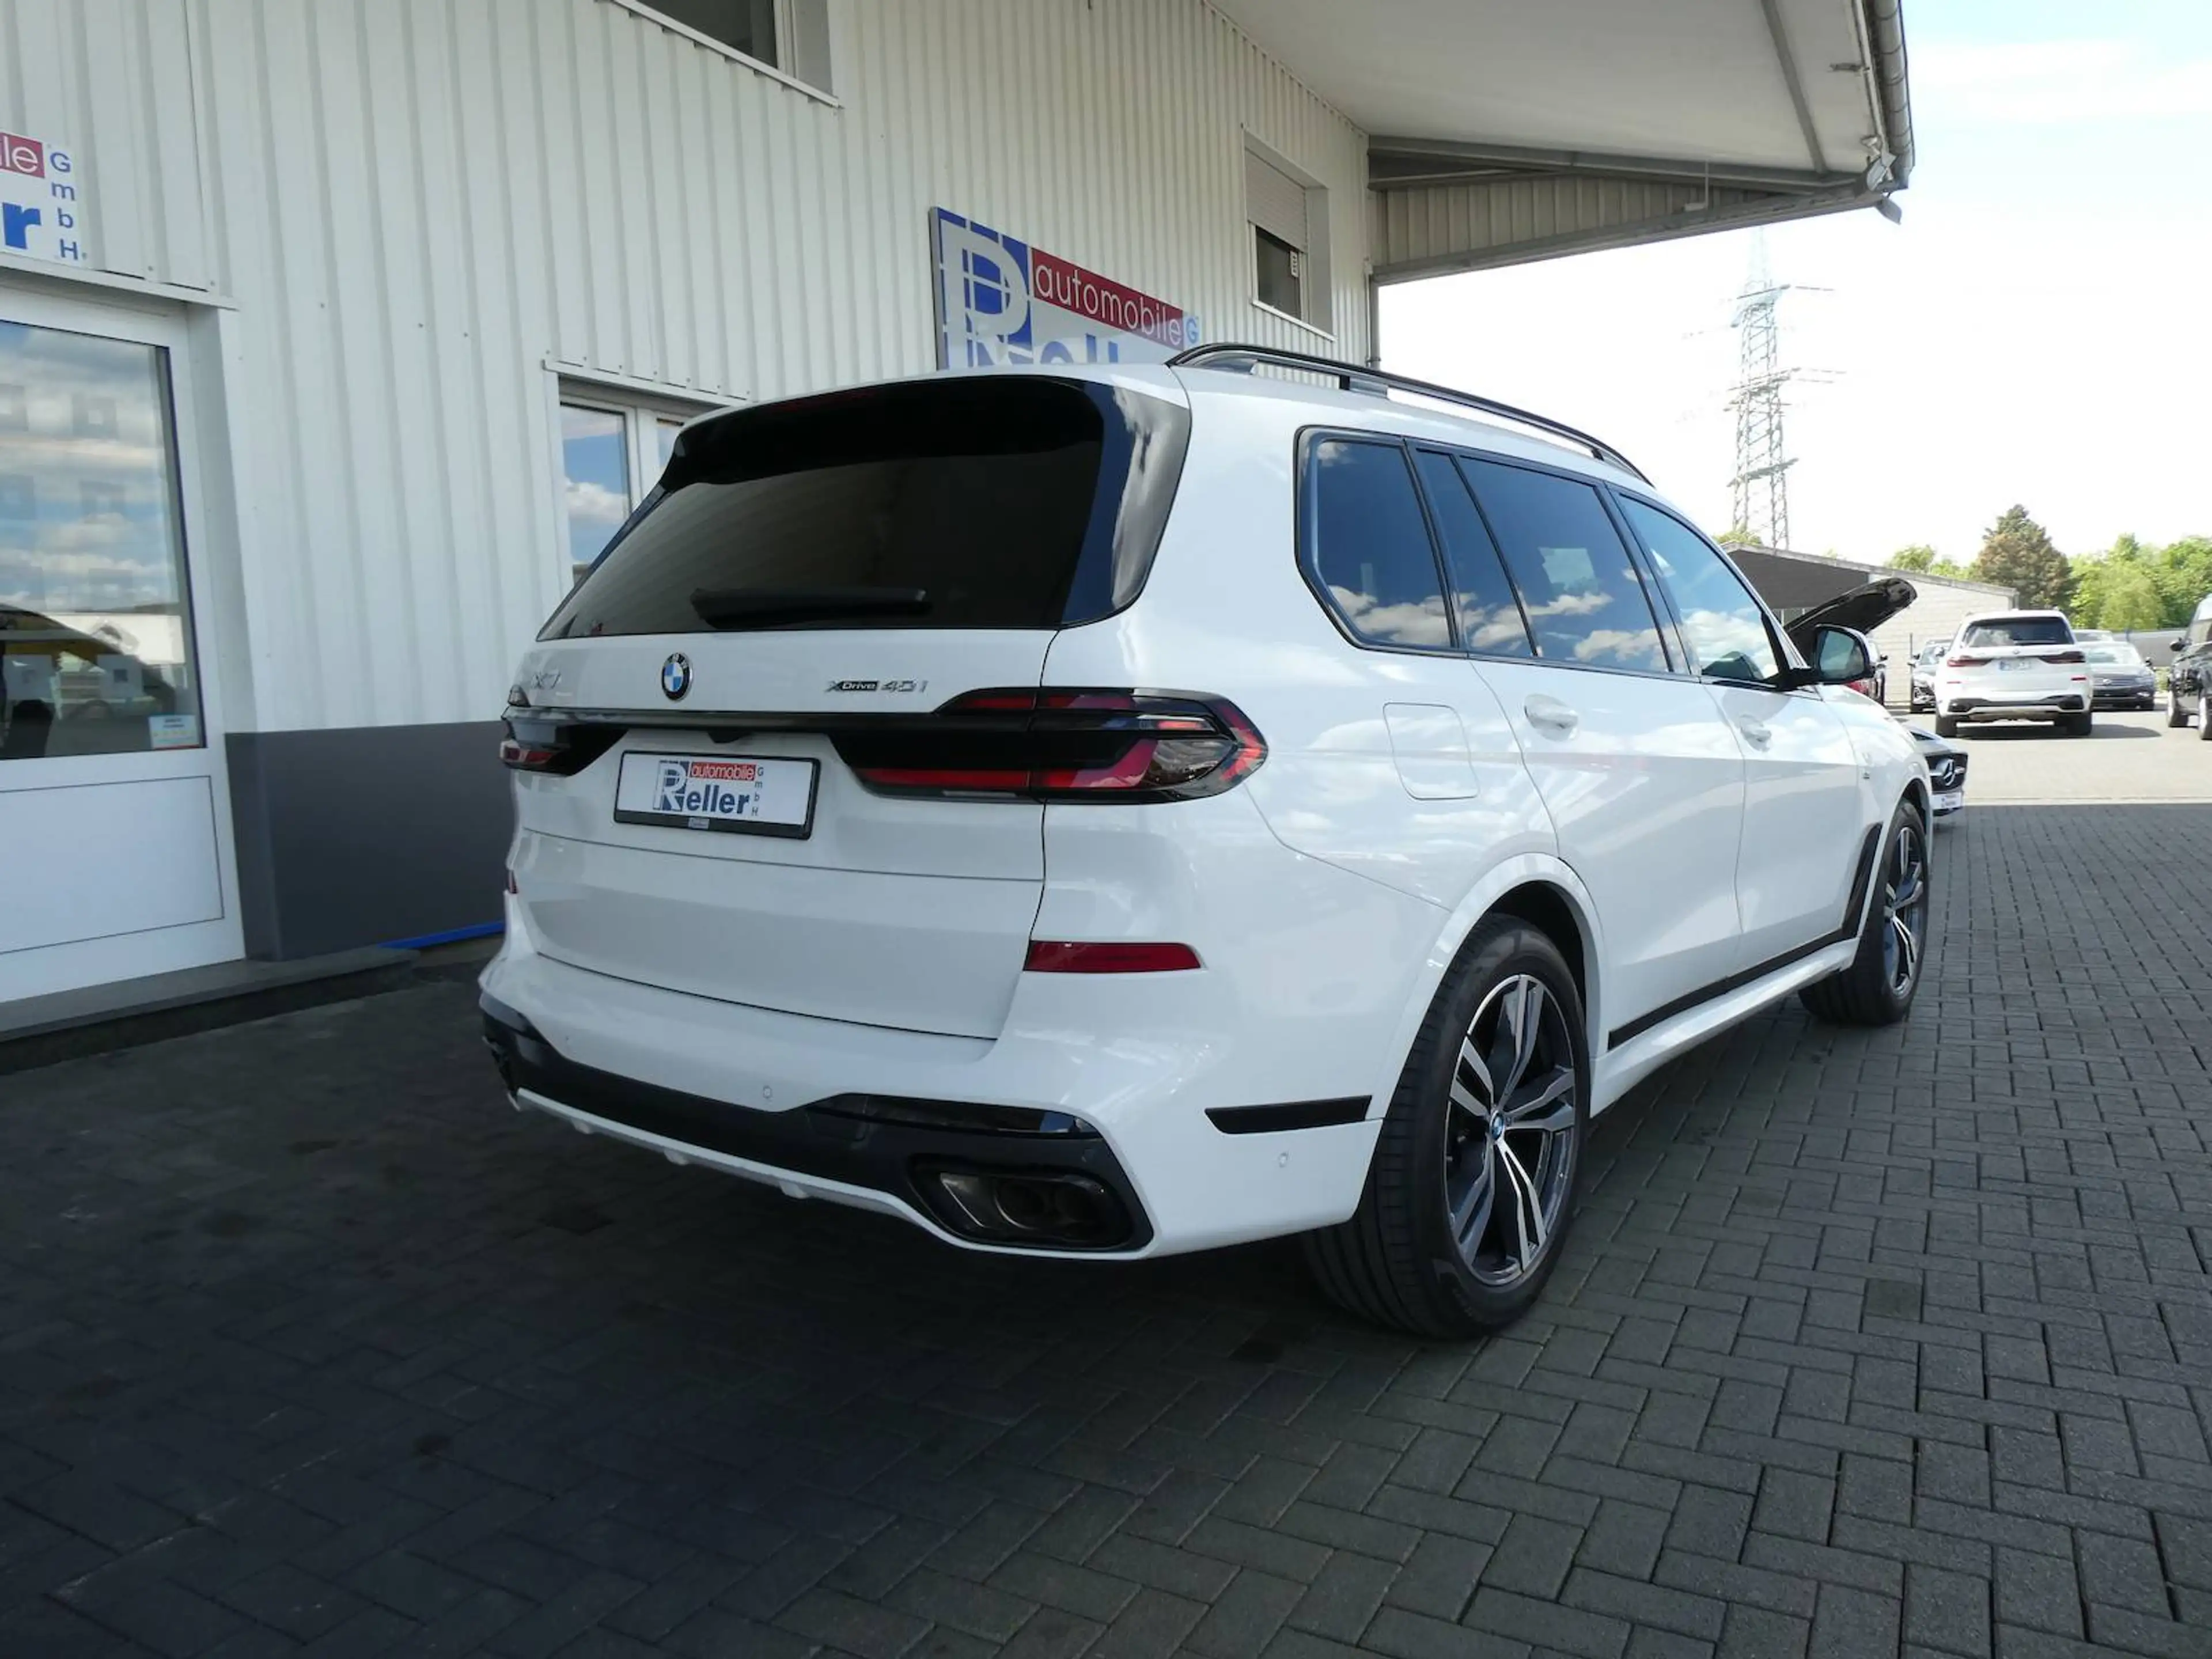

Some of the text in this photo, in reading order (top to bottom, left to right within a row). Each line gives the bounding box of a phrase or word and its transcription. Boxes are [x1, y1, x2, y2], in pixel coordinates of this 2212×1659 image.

[1036, 264, 1183, 345] automobile
[653, 760, 751, 815] Reller
[691, 764, 755, 780] automobile
